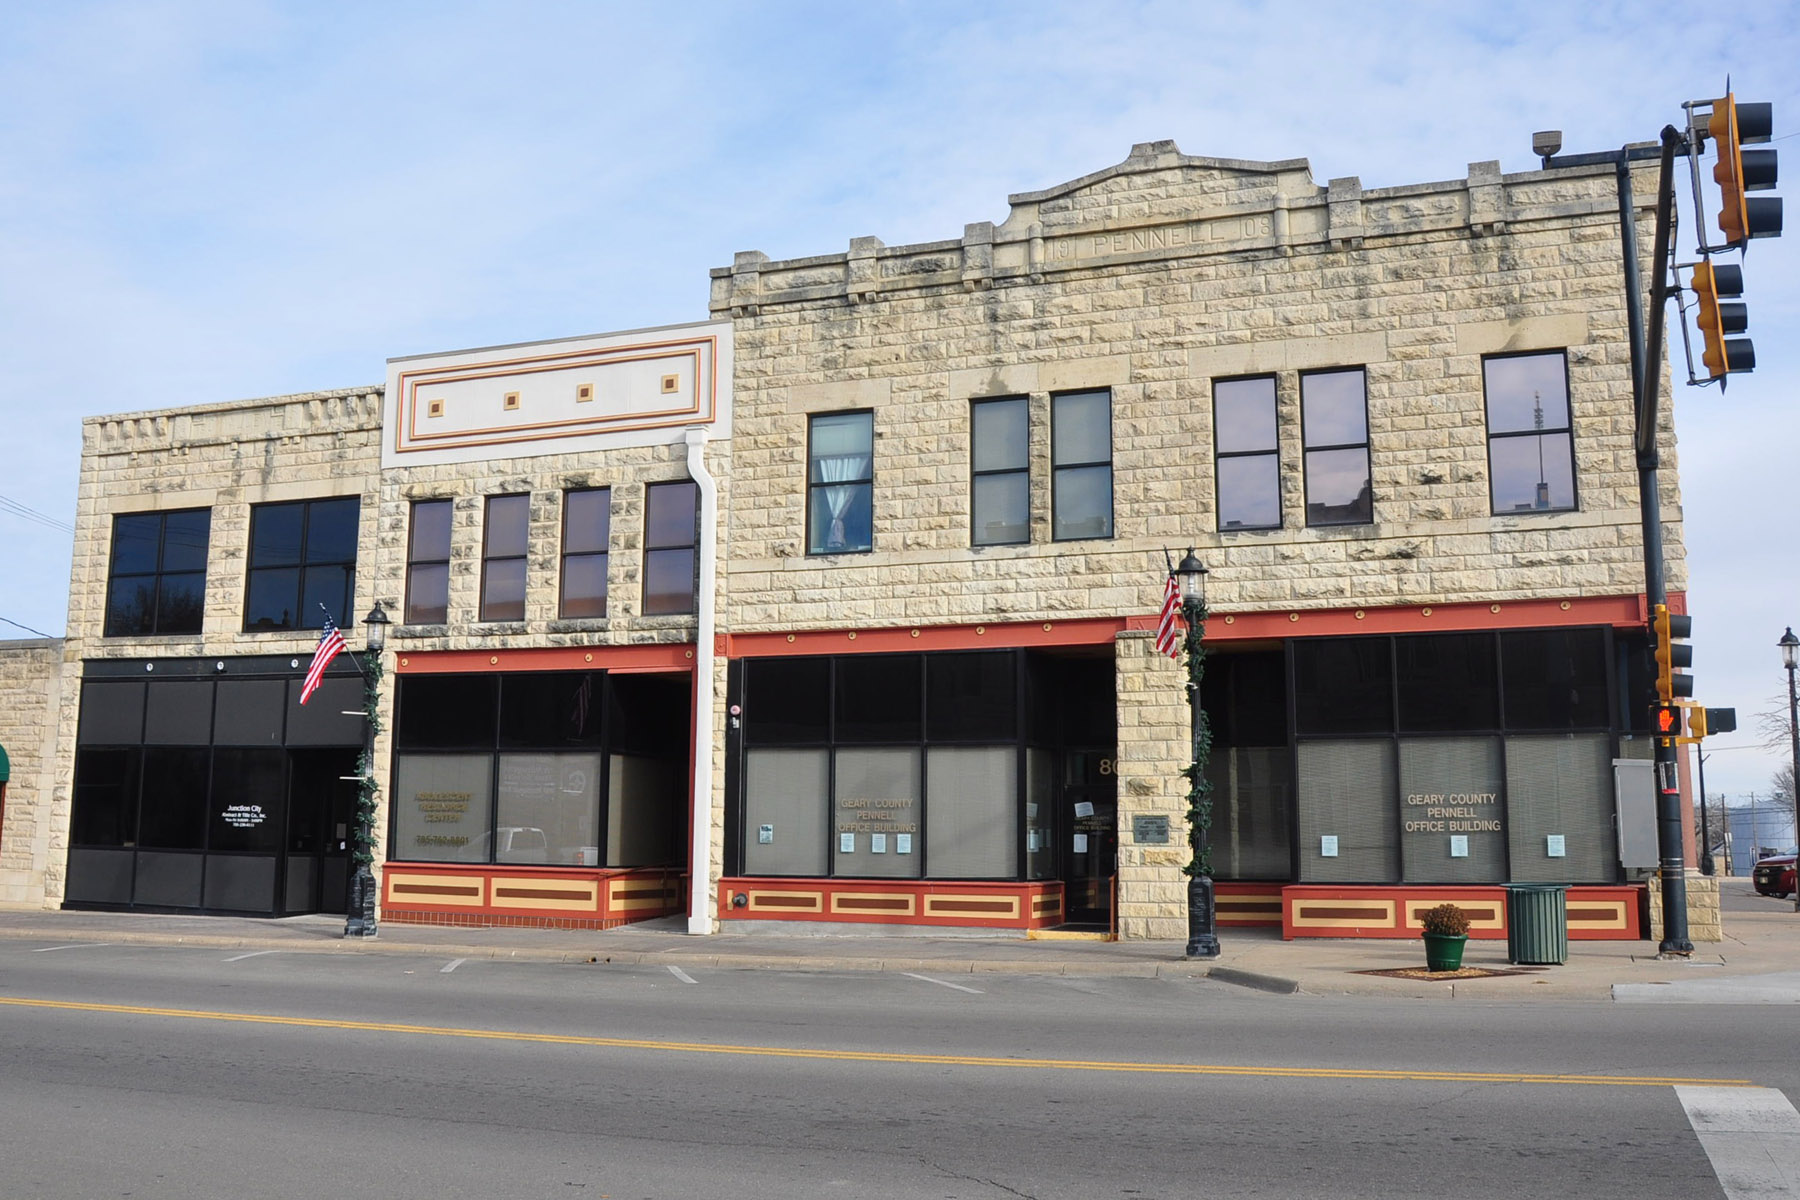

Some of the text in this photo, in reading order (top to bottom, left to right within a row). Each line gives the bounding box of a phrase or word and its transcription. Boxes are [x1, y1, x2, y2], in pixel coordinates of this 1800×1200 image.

[1052, 216, 1271, 259] 19 PENNELL 08
[841, 798, 913, 808] GEARY COUNTY
[1407, 793, 1496, 805] GEARY COUNTY
[251, 804, 262, 813] City
[1427, 807, 1477, 818] PENNELL
[857, 810, 896, 820] PENNELL
[838, 822, 917, 833] OFFICE BUILDING
[1405, 820, 1501, 832] OFFICE BUILDING
